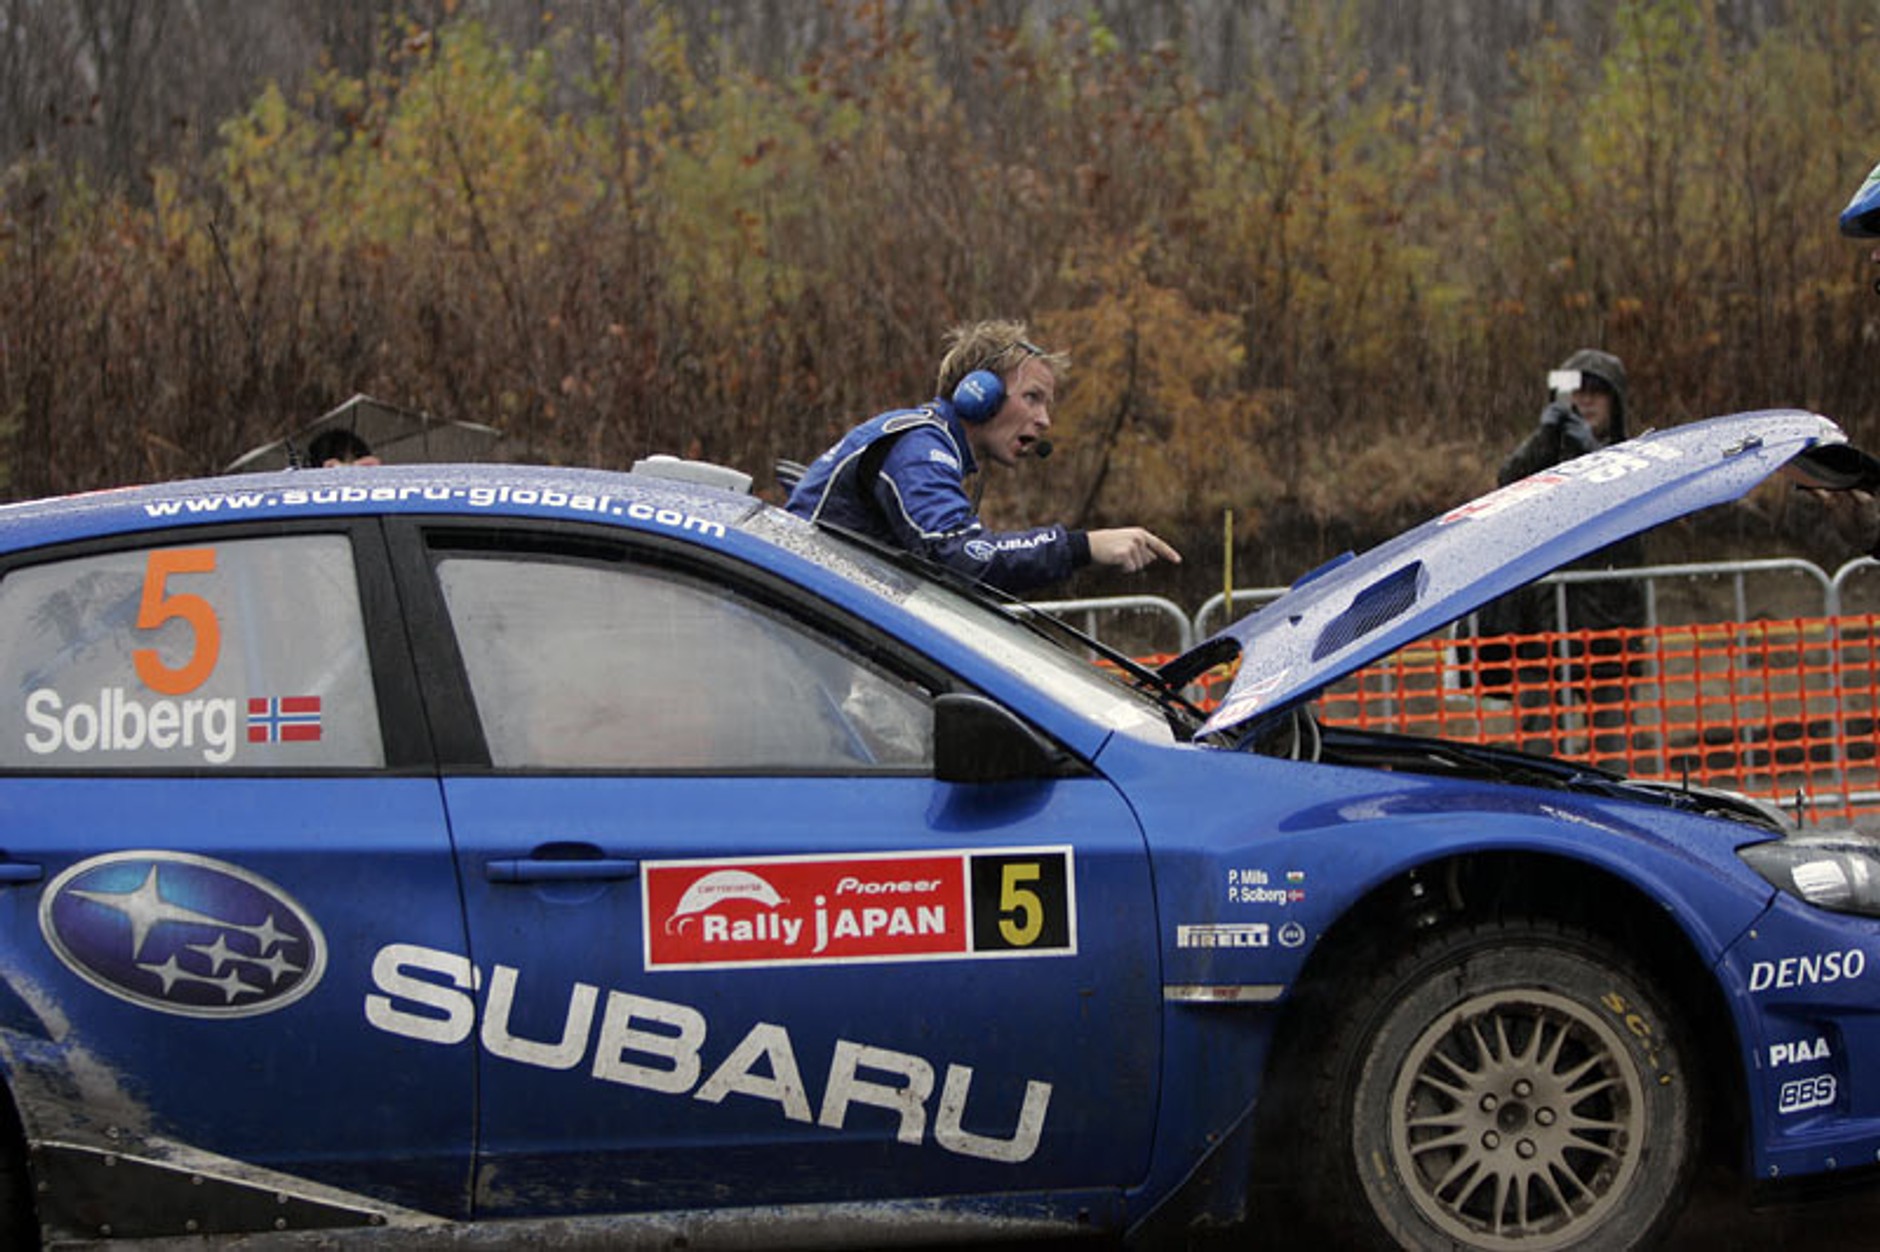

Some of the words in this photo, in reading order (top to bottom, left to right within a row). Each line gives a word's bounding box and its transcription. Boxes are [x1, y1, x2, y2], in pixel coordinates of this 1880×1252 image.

[144, 484, 727, 539] www.subaru-global.com
[993, 529, 1057, 551] UBARU
[132, 548, 221, 696] 5
[25, 688, 237, 765] Solberg
[835, 877, 942, 895] Pioneer
[998, 863, 1044, 947] 5
[1241, 887, 1287, 906] Solberg
[702, 913, 803, 945] Rally
[1177, 923, 1269, 948] PIRELLI
[1749, 949, 1865, 991] DENSO
[365, 943, 1052, 1163] SUBARU
[1769, 1037, 1831, 1068] PIAA
[1778, 1074, 1837, 1114] BBS
